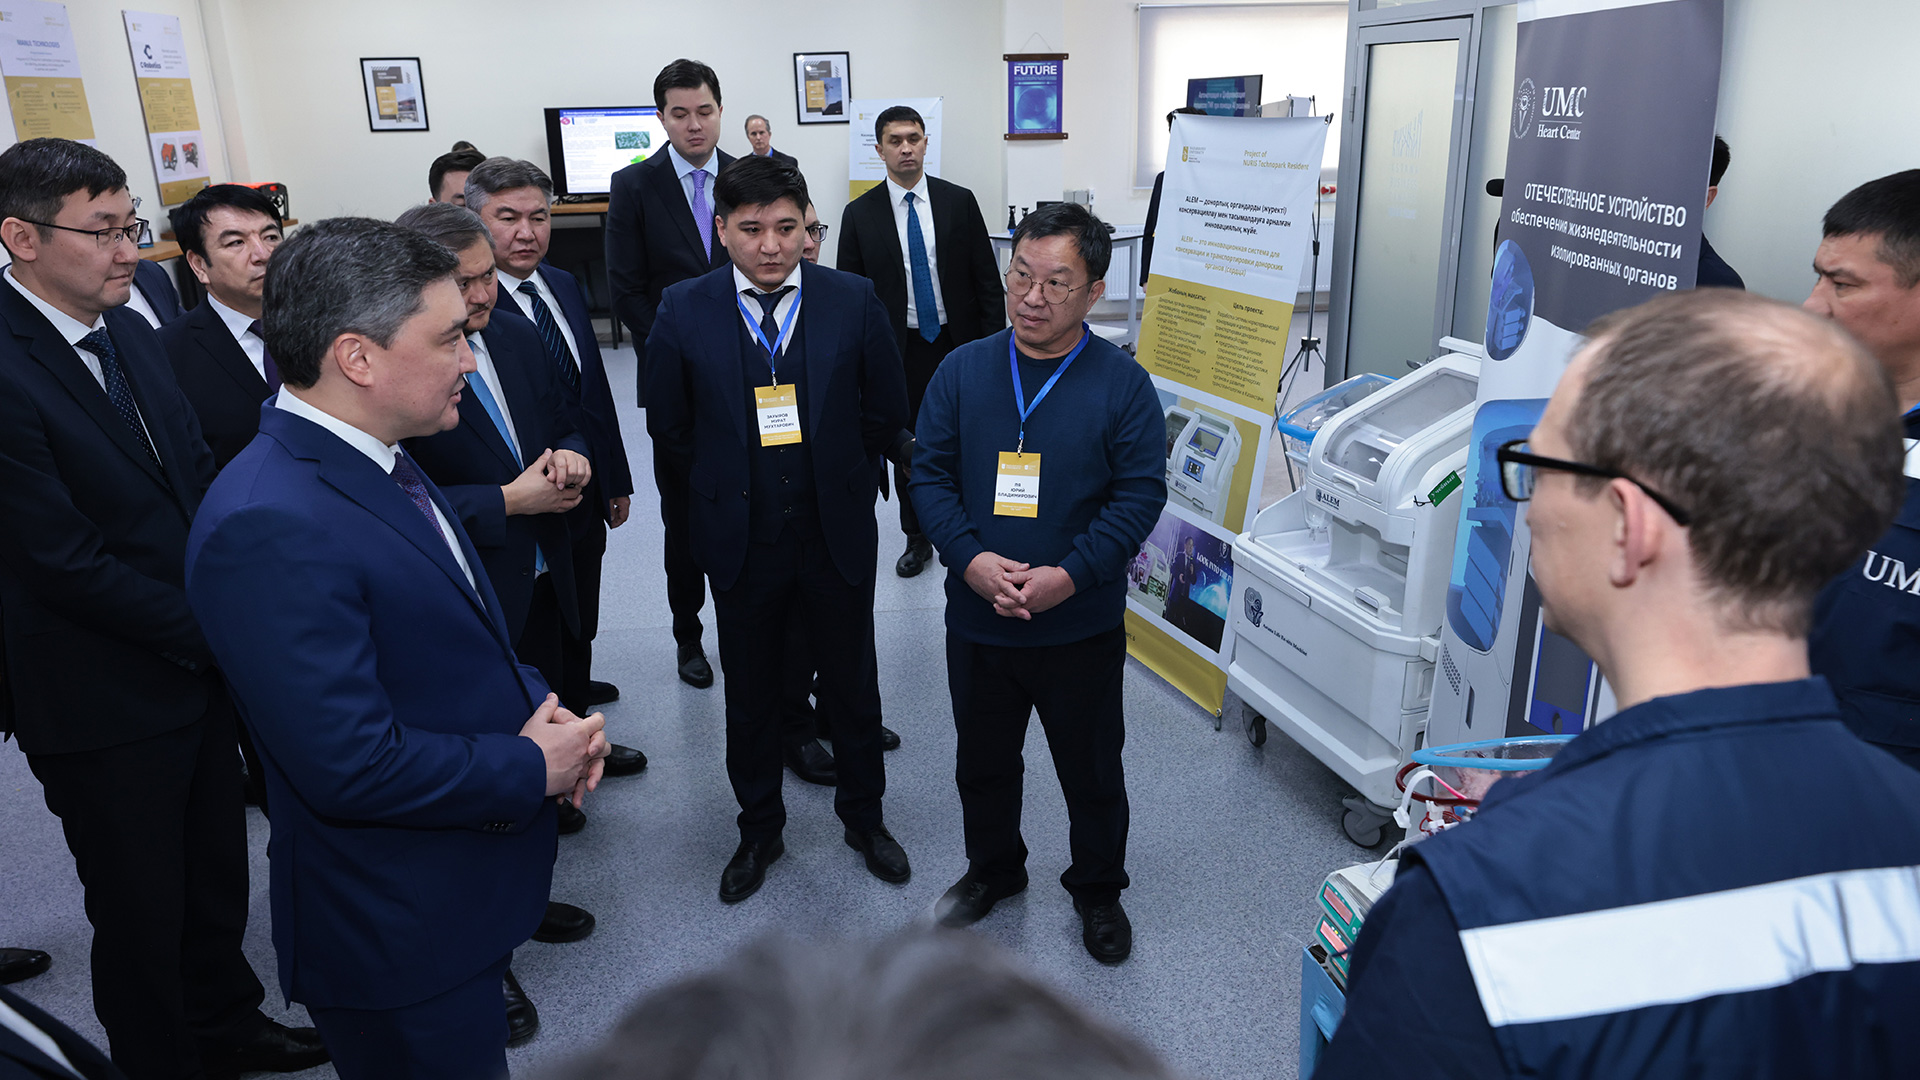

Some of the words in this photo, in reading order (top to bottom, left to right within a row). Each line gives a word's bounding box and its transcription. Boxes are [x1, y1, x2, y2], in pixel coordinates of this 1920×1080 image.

[1014, 65, 1057, 75] FUTURE
[1542, 86, 1587, 117] UMC
[1537, 124, 1559, 138] Heart
[1560, 125, 1581, 140] Center
[1244, 150, 1260, 158] Project
[1258, 160, 1286, 170] Technopark
[1287, 162, 1309, 170] Resident
[1525, 183, 1606, 213] ОТЕЧЕСТВЕННОЕ
[1608, 196, 1687, 228] УСТРОЙСТВО
[1511, 208, 1567, 234] обеспечения
[1568, 222, 1682, 260] жизнедеятельности
[1248, 248, 1269, 256] система
[1551, 244, 1622, 277] изолированных
[1623, 265, 1678, 290] органов
[1321, 493, 1340, 507] ALEM
[1196, 552, 1208, 567] LOOK
[1209, 561, 1220, 574] INTO
[1863, 550, 1920, 596] UM
